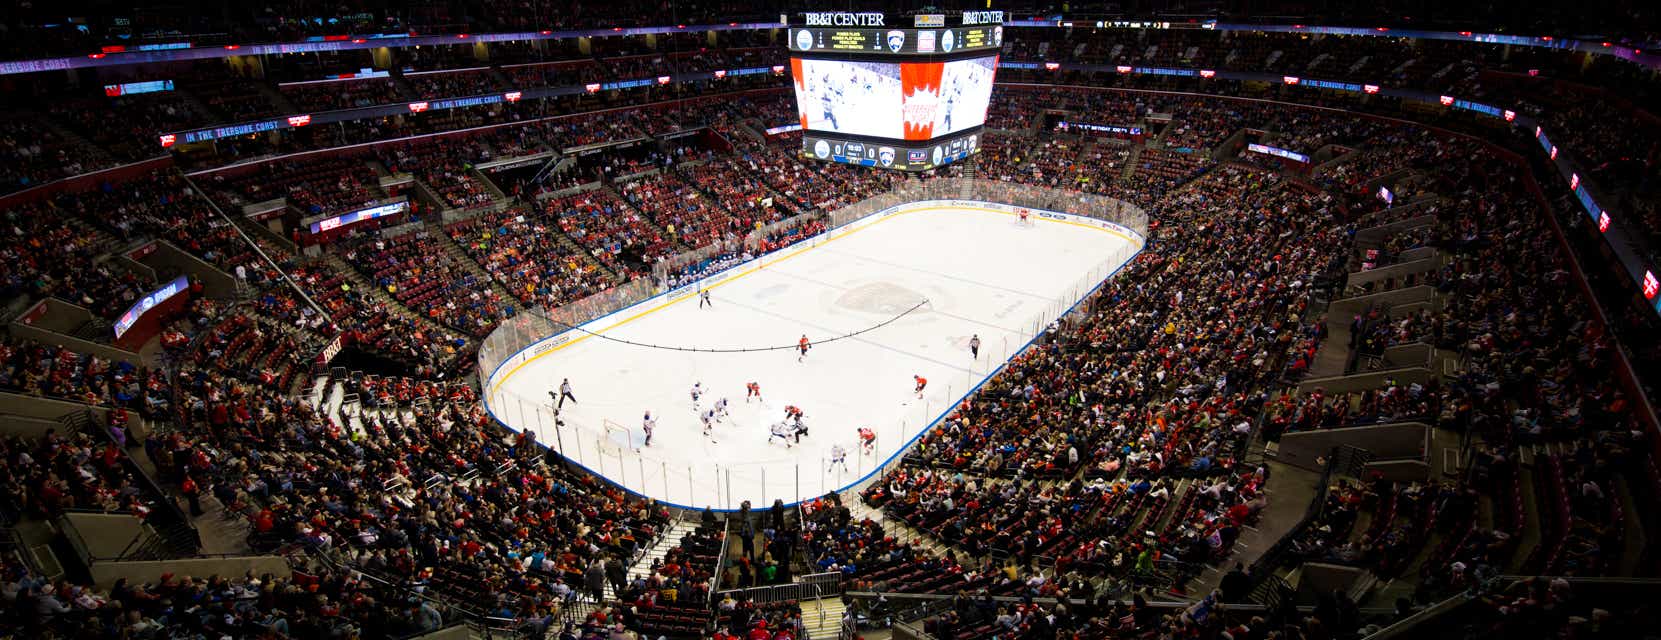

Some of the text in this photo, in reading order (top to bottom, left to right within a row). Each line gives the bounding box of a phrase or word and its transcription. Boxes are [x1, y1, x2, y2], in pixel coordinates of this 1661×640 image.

[805, 12, 885, 26] BB&T CENTER
[962, 11, 1004, 25] BB&T CENTER
[44, 58, 71, 71] COAST
[186, 133, 195, 142] IN
[198, 131, 213, 141] THE
[216, 125, 254, 139] TREASURE
[255, 121, 279, 132] COAST
[835, 144, 841, 155] 0
[868, 148, 875, 158] 0
[322, 335, 343, 364] BB&T
